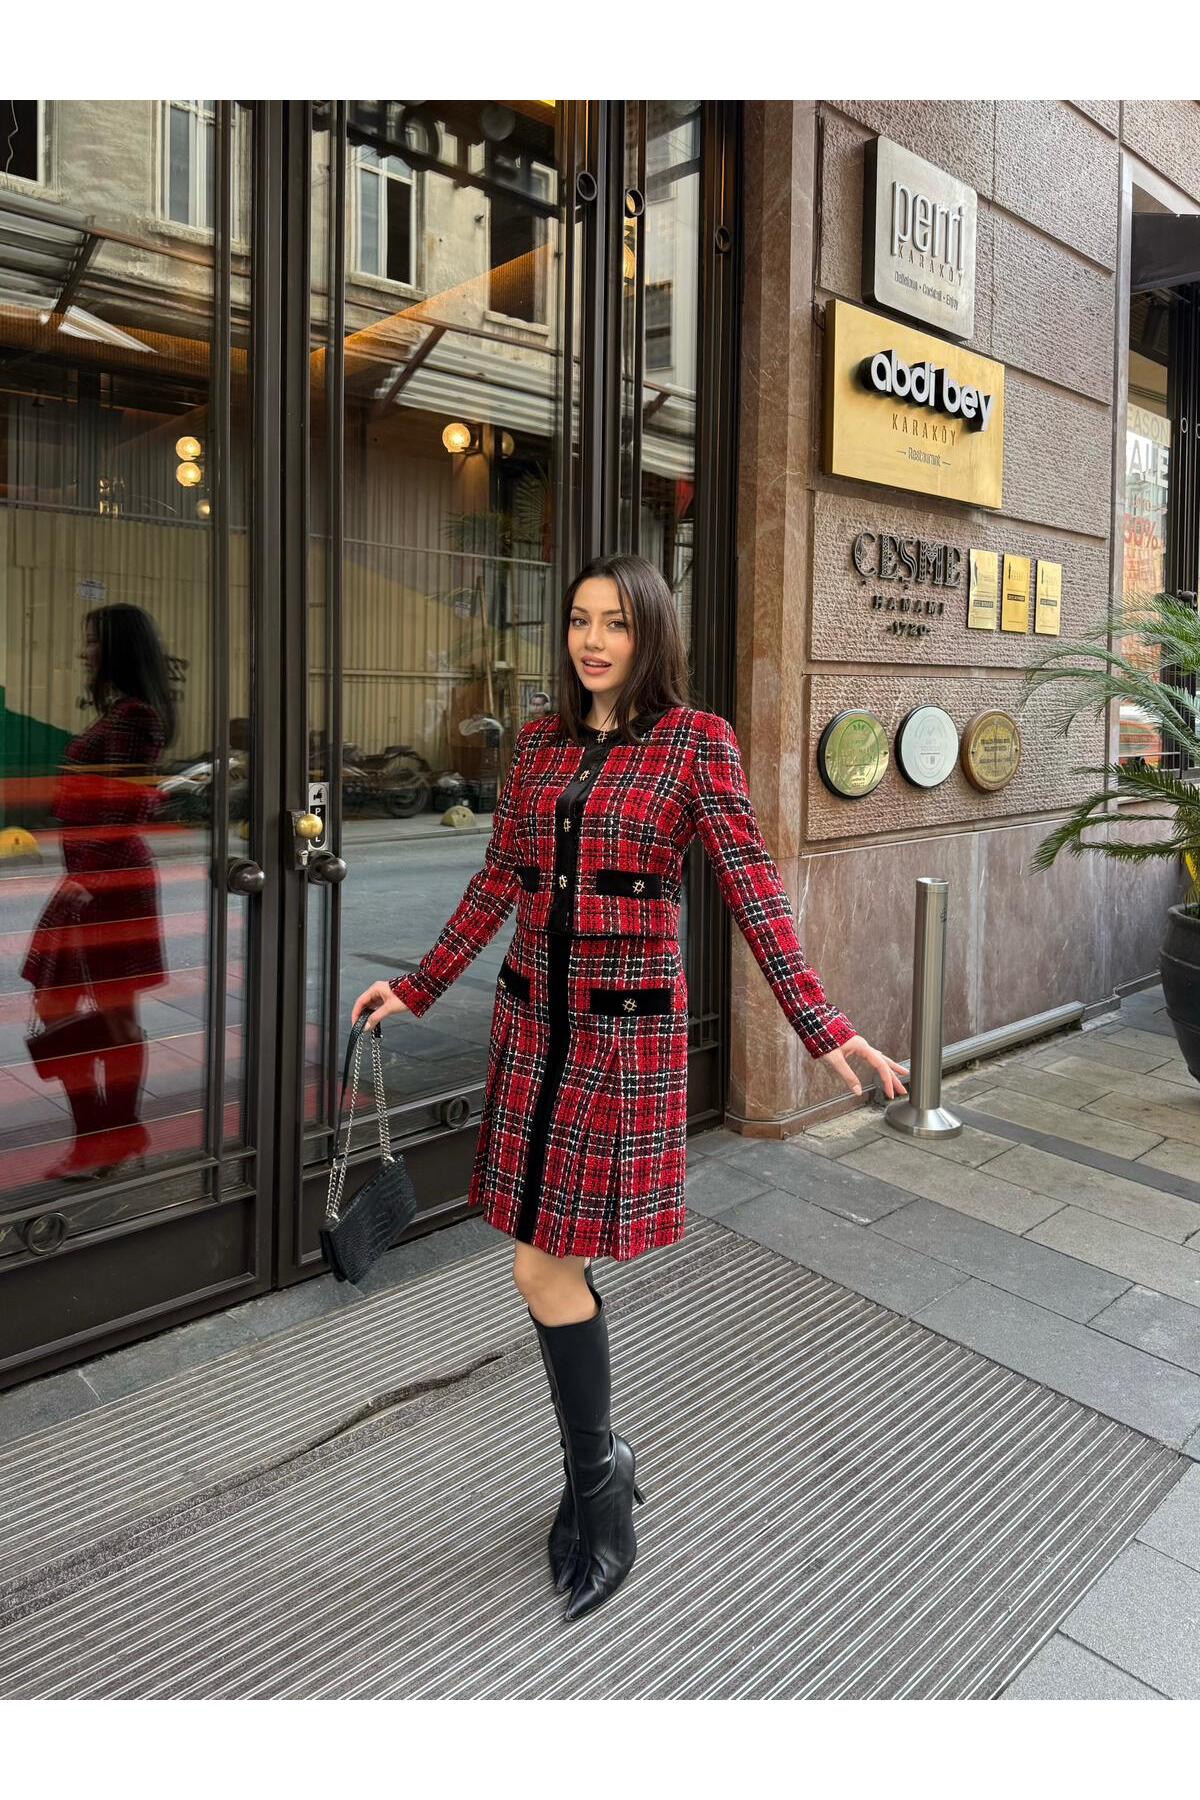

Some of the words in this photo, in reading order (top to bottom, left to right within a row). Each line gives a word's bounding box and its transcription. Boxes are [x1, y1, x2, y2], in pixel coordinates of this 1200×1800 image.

[871, 350, 936, 407] abdi
[943, 368, 994, 432] bey
[892, 413, 956, 446] KARAKÖY
